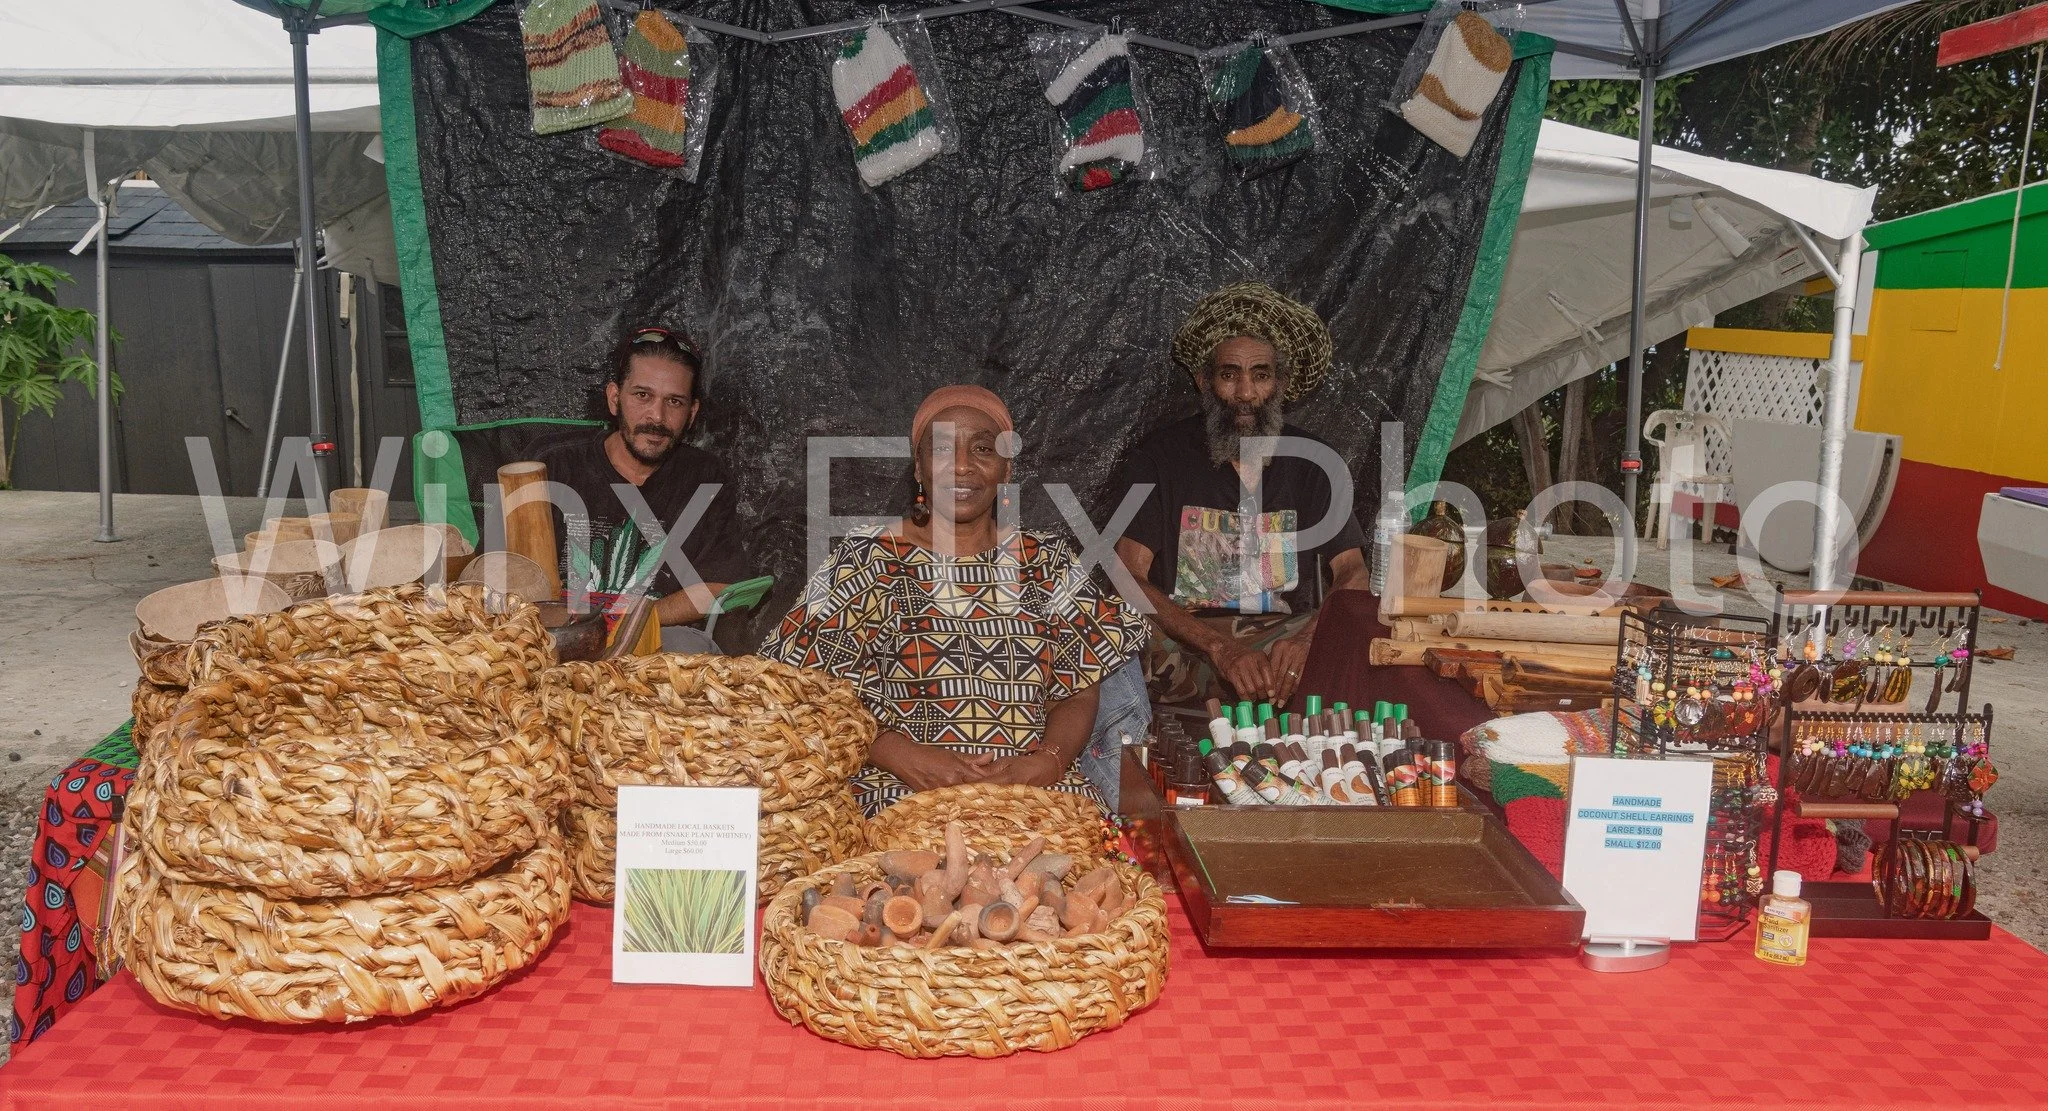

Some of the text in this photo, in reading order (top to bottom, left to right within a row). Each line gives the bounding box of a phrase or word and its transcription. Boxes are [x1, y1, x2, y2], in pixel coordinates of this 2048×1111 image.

[1612, 798, 1662, 807] HANDMADE
[1578, 810, 1694, 823] COCONUT SHELL EARRINGS
[678, 823, 701, 831] LOCAL
[703, 823, 735, 831] BASKETS
[1606, 825, 1663, 836] LARGE $15.00
[664, 831, 690, 839] (SNAKE
[691, 831, 714, 839] PLANT
[716, 832, 752, 841] WHITNEY)
[661, 839, 686, 847] Medium
[1605, 840, 1662, 850] SMALL $12.00
[665, 847, 682, 856] Large
